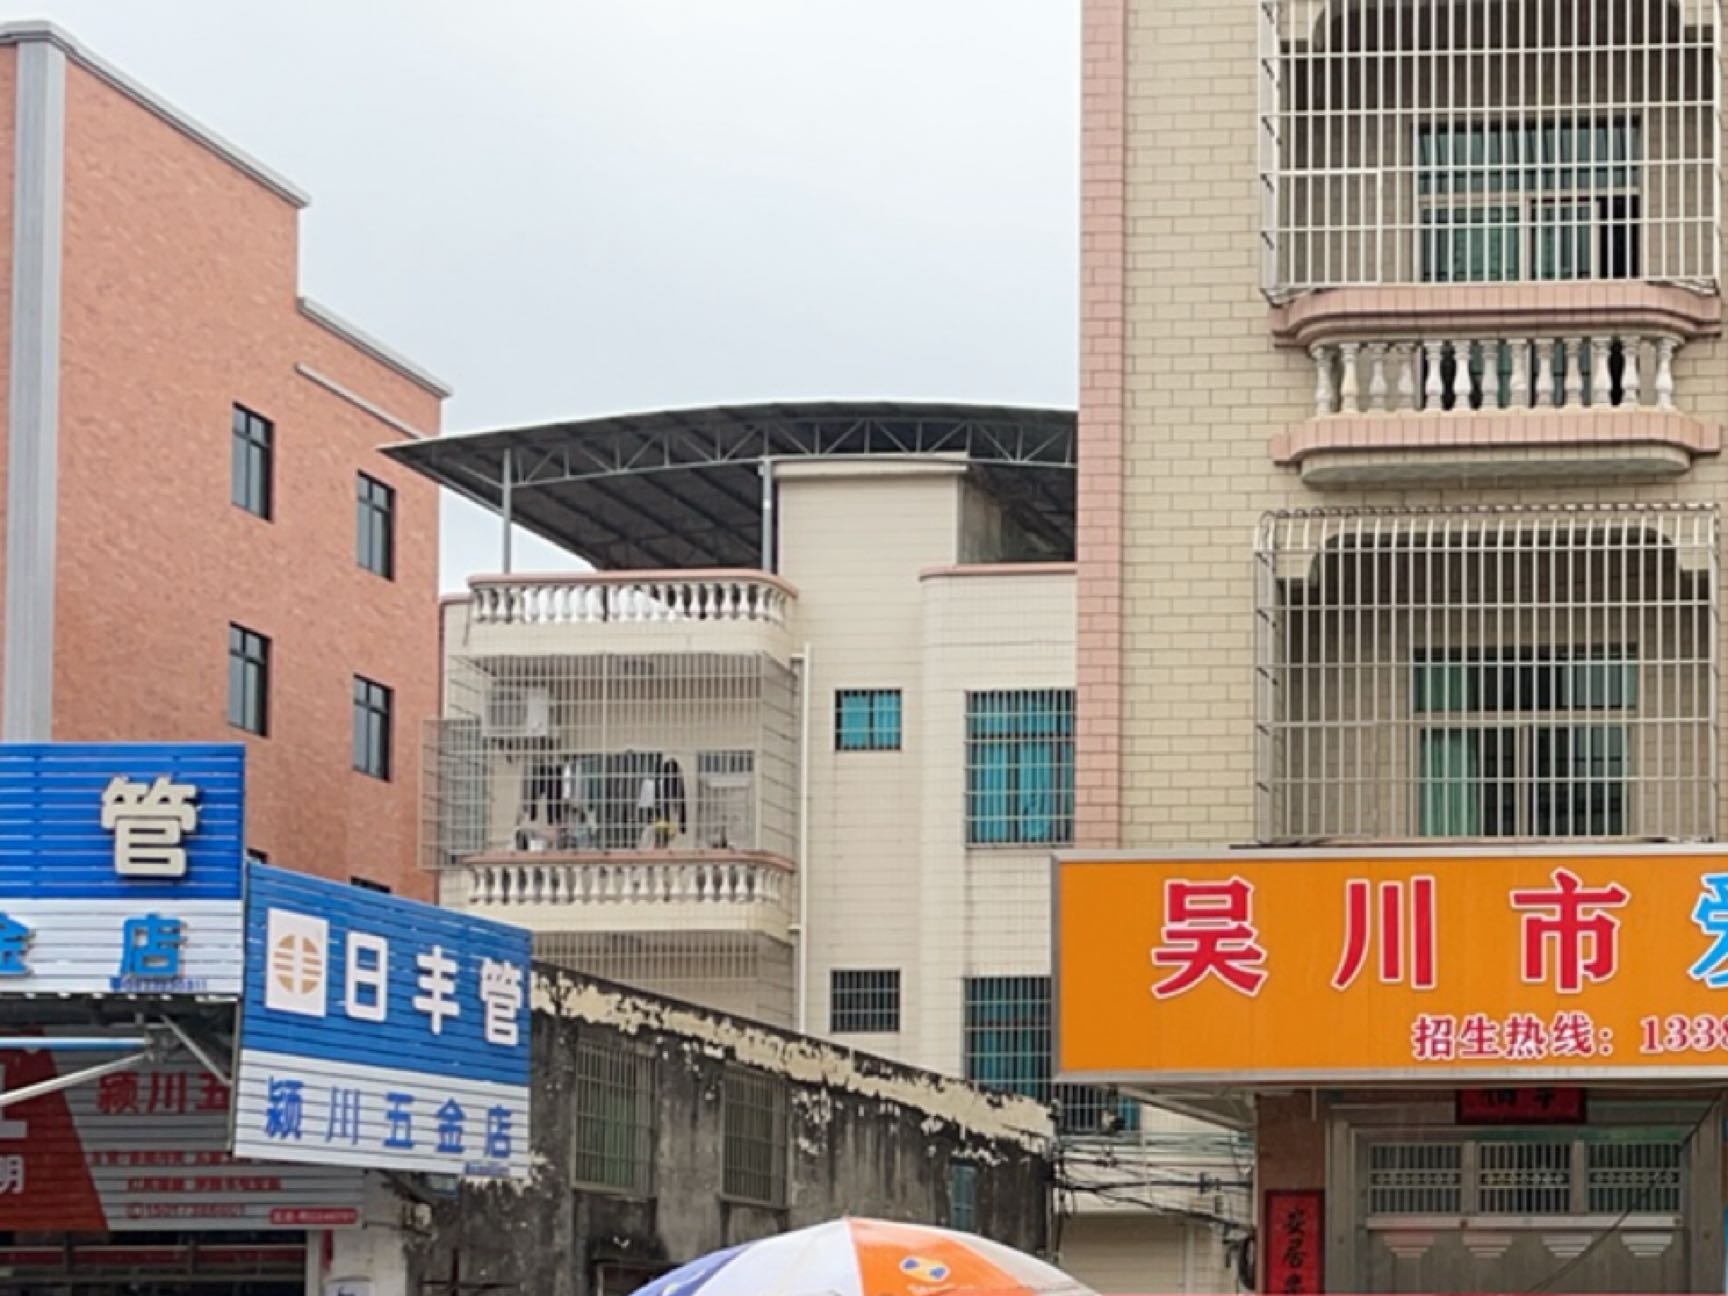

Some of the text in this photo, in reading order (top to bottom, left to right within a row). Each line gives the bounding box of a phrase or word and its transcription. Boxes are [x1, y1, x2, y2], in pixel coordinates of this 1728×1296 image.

[102, 776, 198, 878] 管
[345, 930, 523, 1047] 日丰管
